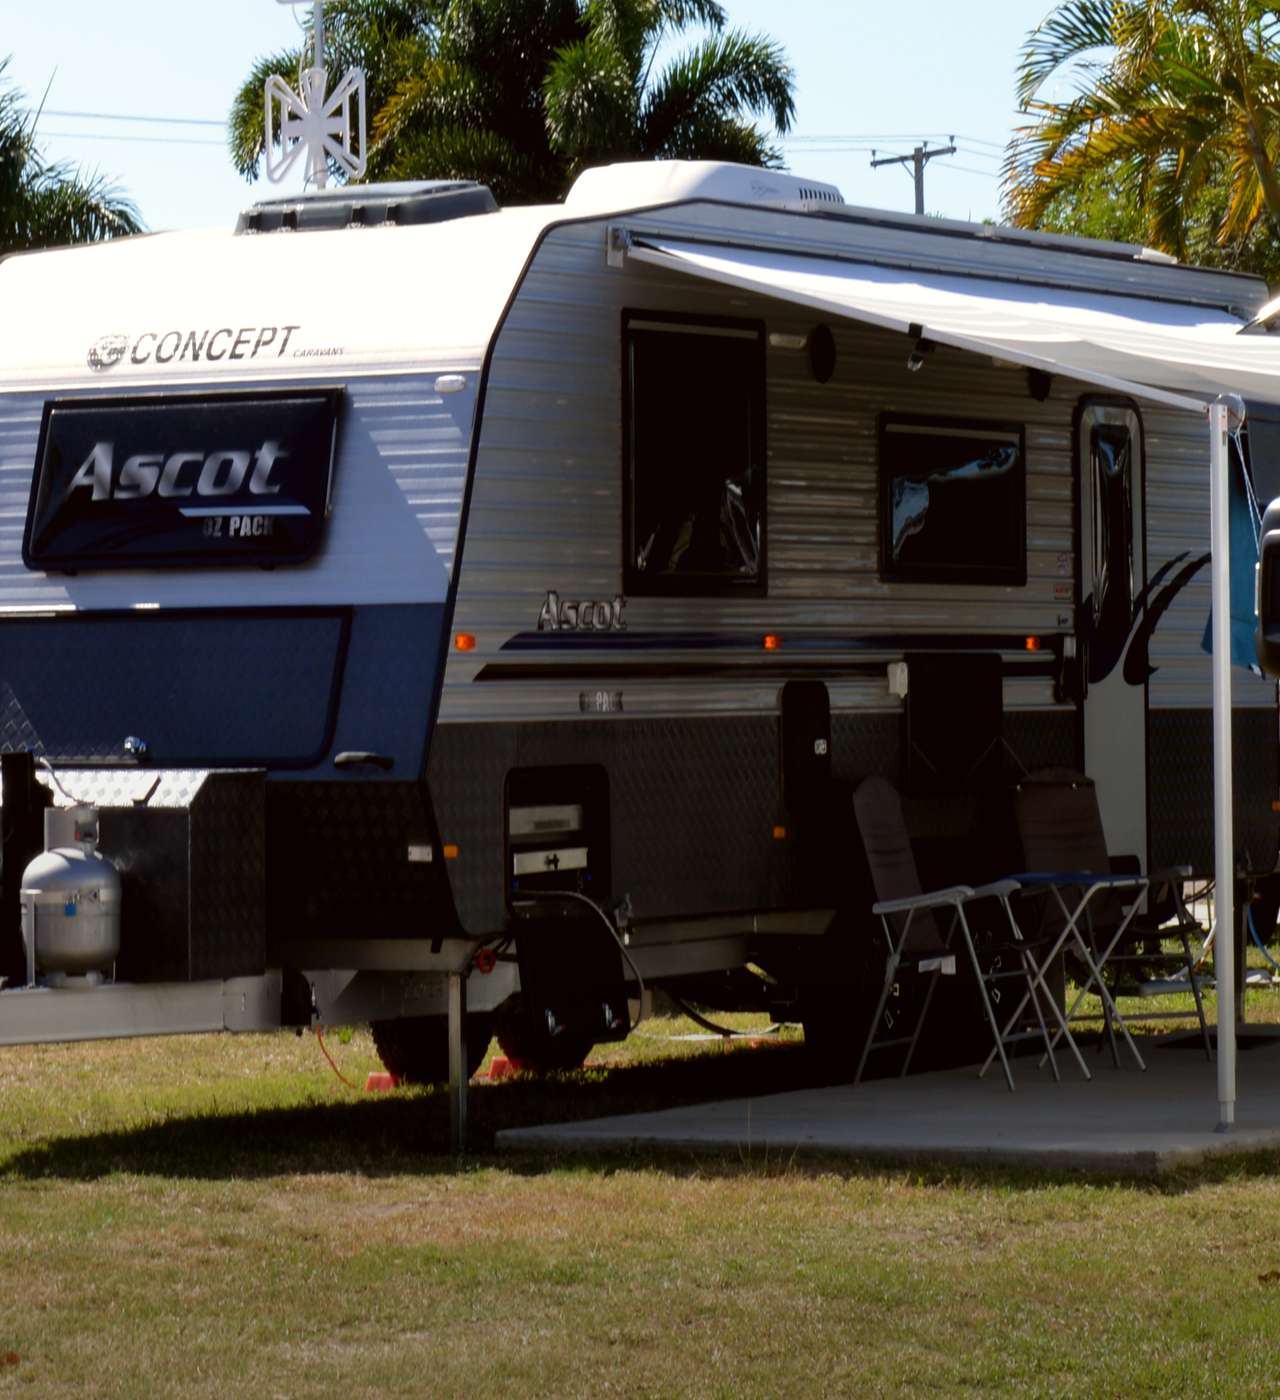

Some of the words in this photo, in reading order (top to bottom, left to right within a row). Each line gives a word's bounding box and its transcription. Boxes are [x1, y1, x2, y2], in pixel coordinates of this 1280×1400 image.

[131, 325, 301, 365] CONCEPT
[70, 441, 289, 501] Ascot
[537, 589, 627, 632] Ascot
